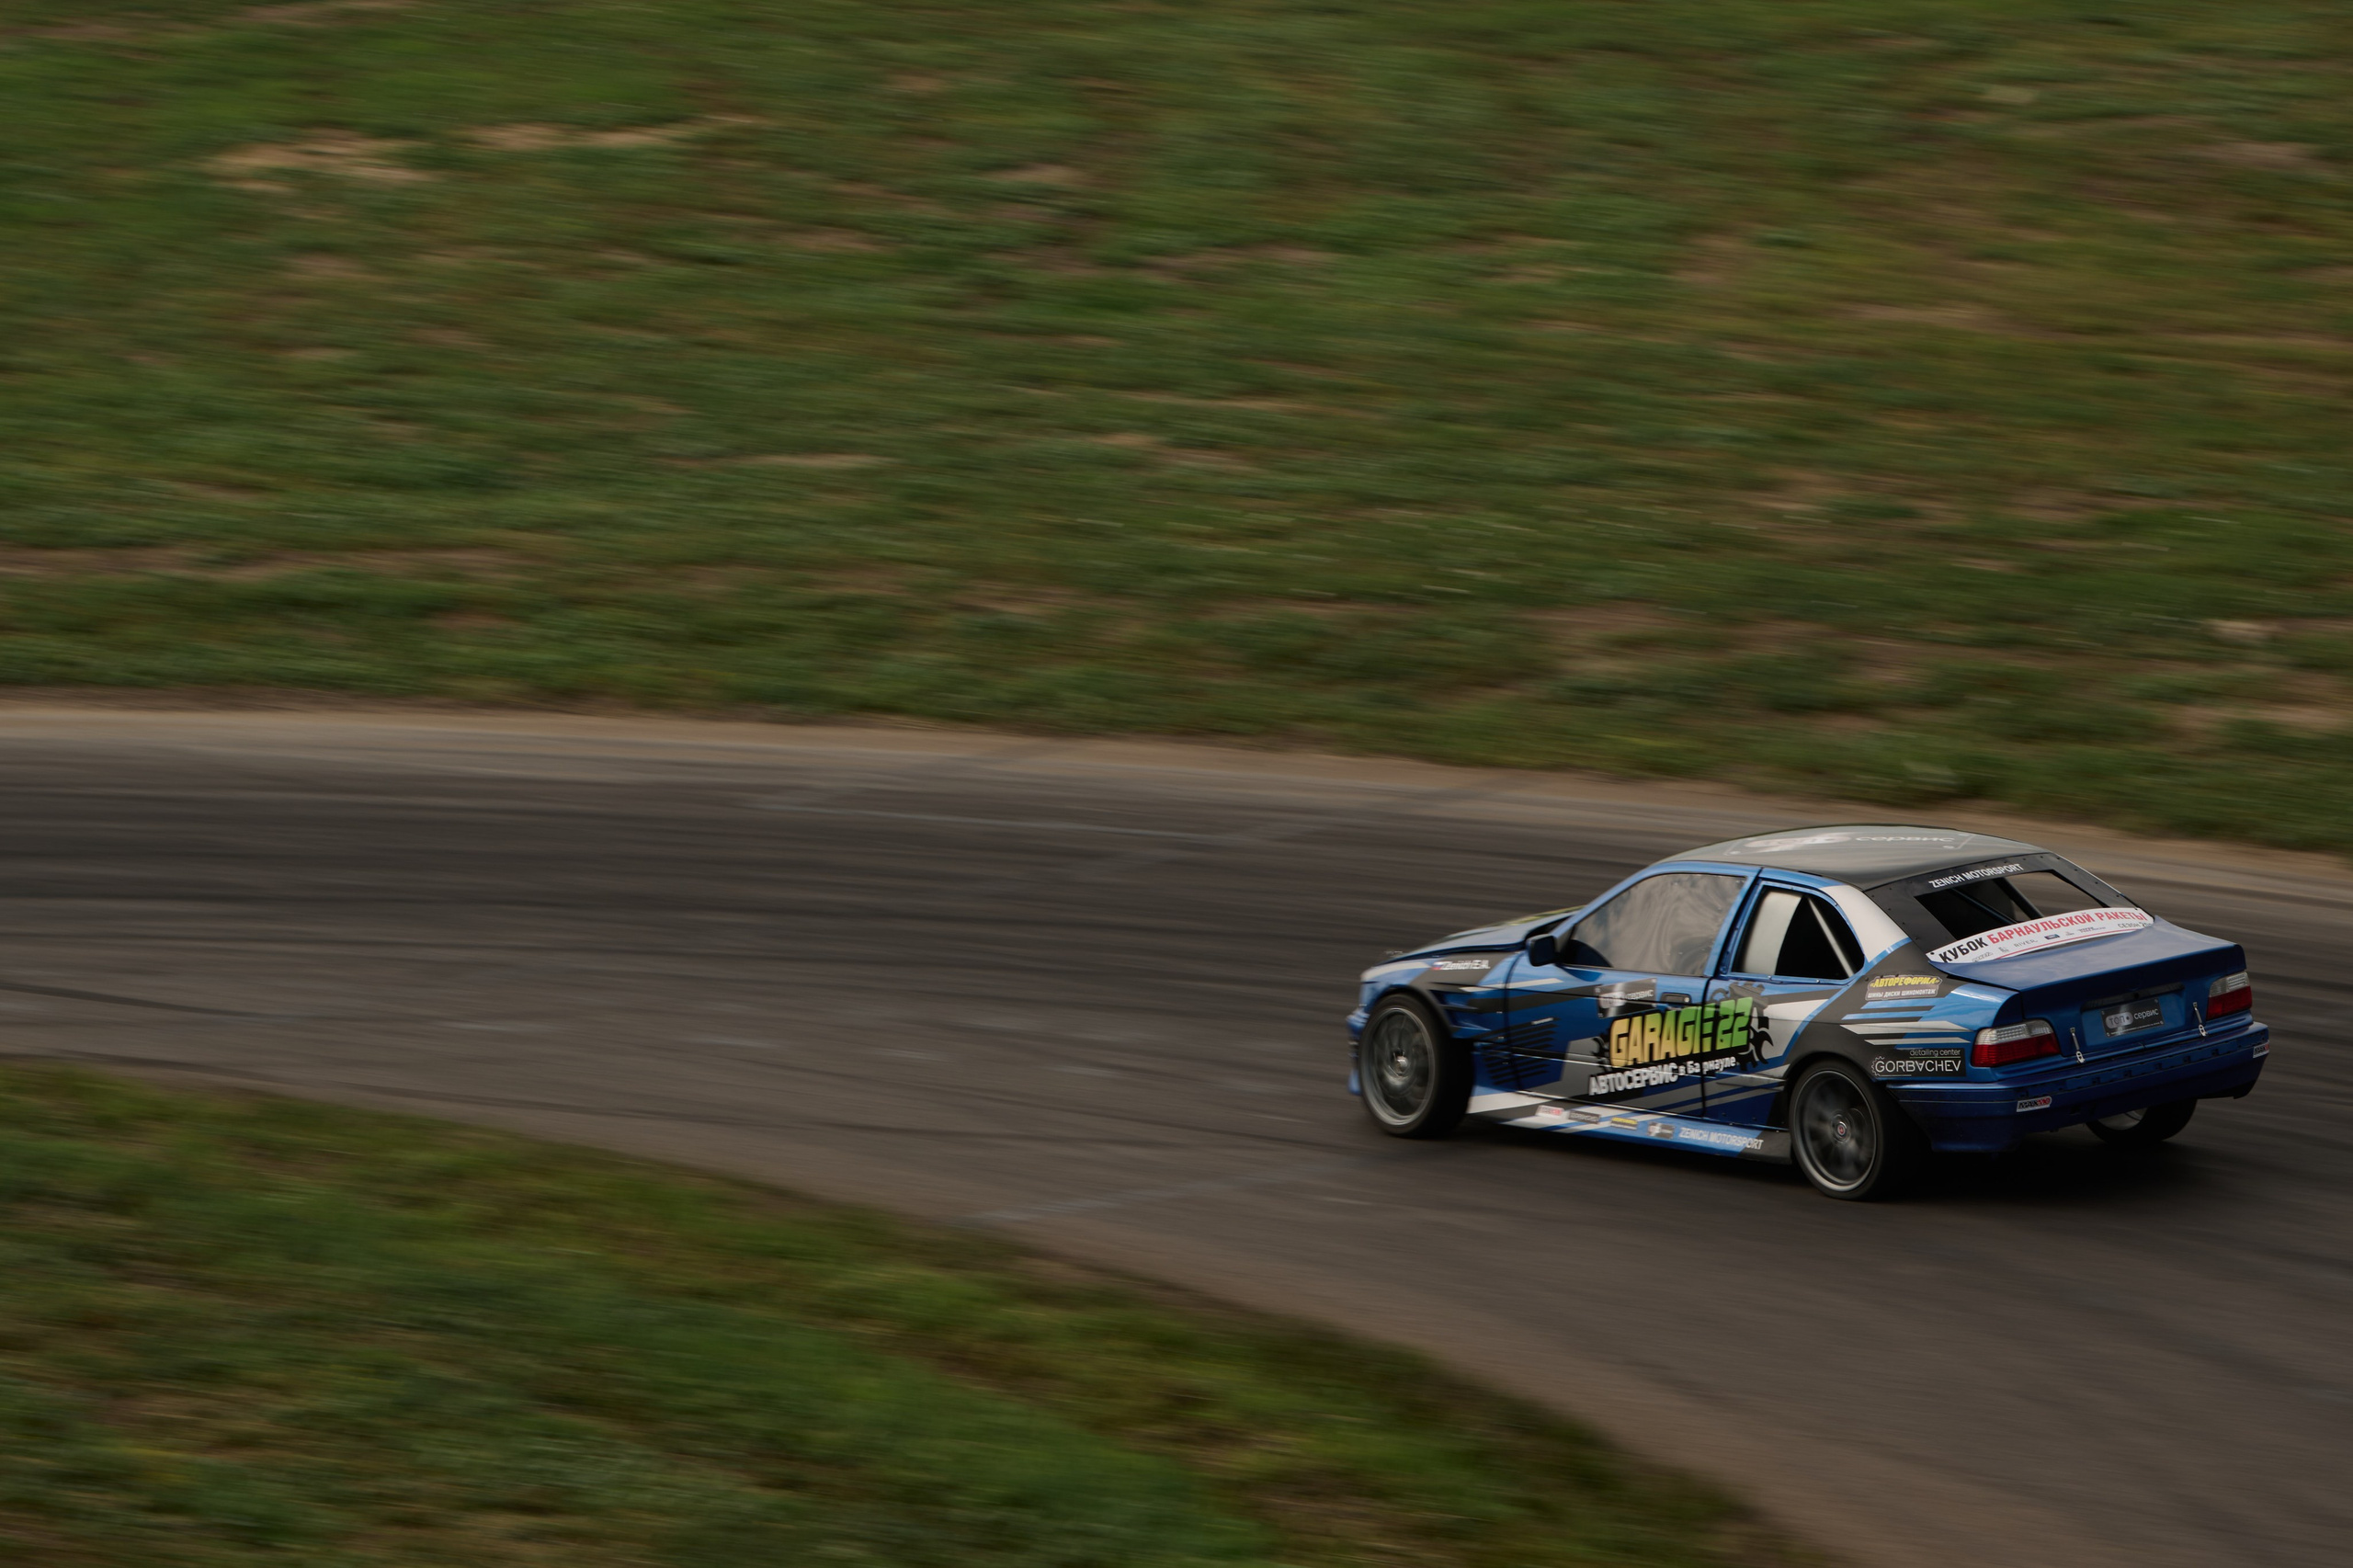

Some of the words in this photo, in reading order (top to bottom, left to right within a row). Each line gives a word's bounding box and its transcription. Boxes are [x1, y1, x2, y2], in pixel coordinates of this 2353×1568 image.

[1928, 873, 1965, 888] ZENICH
[1961, 863, 2024, 881] MOTORSPORT
[1938, 937, 1988, 963] КУБОК
[1987, 912, 2093, 945] БАРНАУЛЬСКОЙ
[2097, 910, 2148, 923] РАКЕТЫ
[1609, 1003, 1716, 1067] GARAGE
[1715, 996, 1753, 1050] 22
[1588, 1062, 1678, 1096] АВТОСЕРВИС
[1677, 1064, 1686, 1076] в
[1678, 1127, 1709, 1141] ZENICH
[1709, 1131, 1765, 1150] MOTORSPORT
